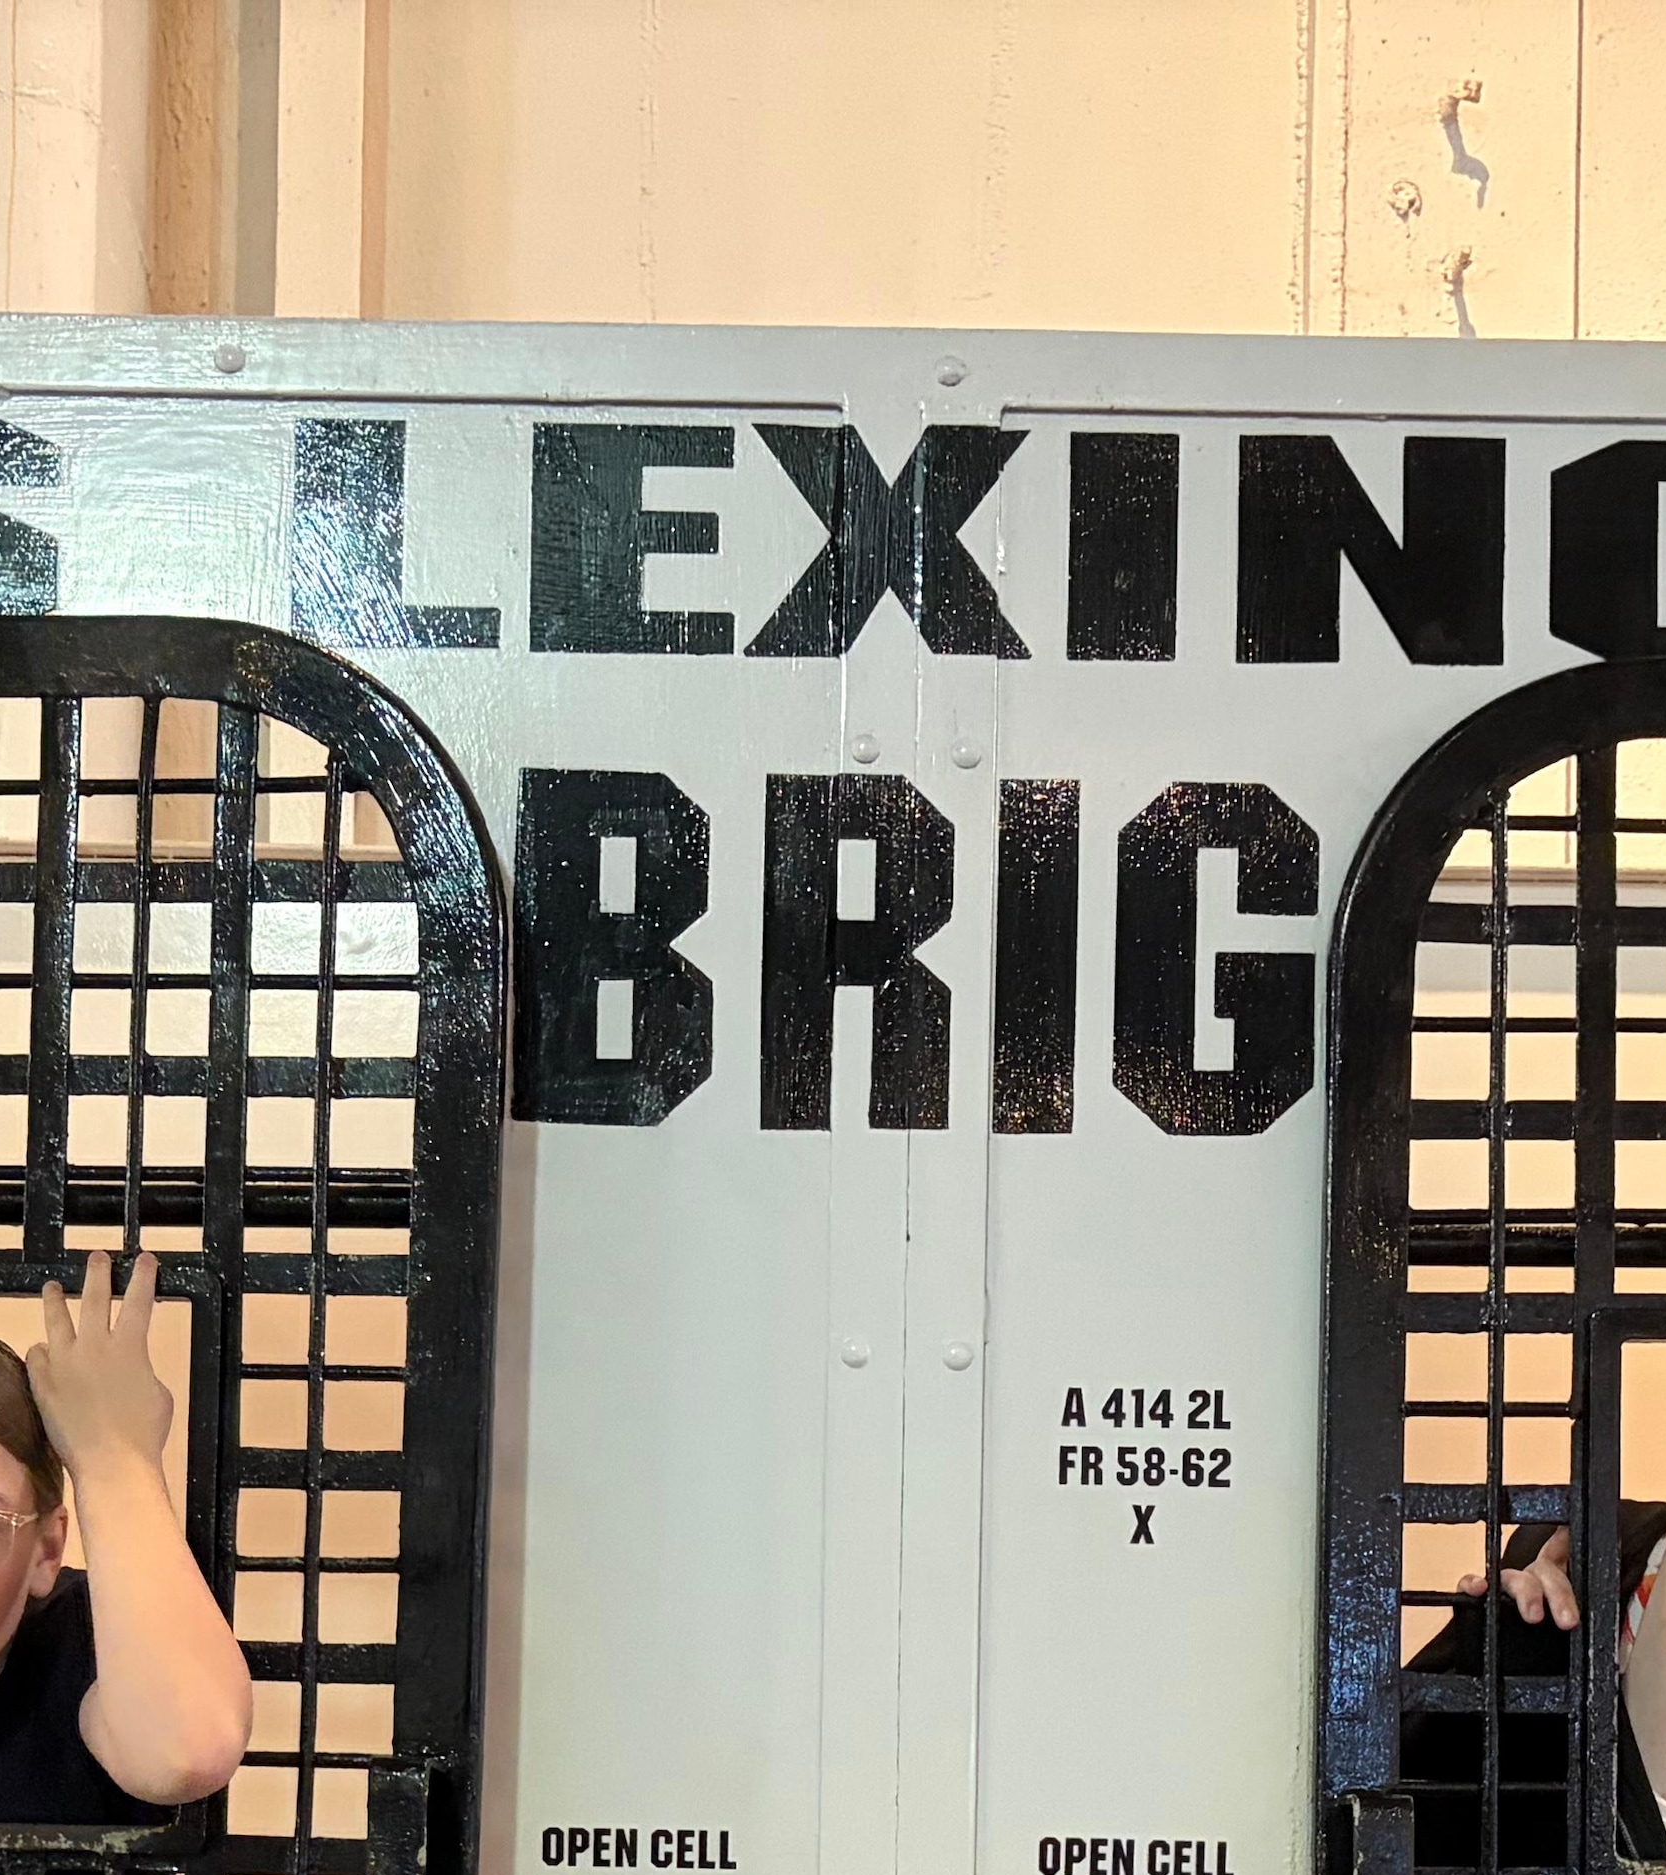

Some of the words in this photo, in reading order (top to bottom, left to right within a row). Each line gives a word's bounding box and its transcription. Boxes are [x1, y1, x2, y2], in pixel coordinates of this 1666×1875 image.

[510, 767, 1320, 1136] BRIG
[1061, 1387, 1087, 1428] A
[1101, 1389, 1174, 1430] 414
[1187, 1390, 1231, 1430] 2L
[1058, 1446, 1103, 1487] FR
[1116, 1447, 1231, 1488] 58-62
[1130, 1505, 1155, 1545] X
[541, 1827, 637, 1868] OPEN
[650, 1829, 737, 1869] CELL
